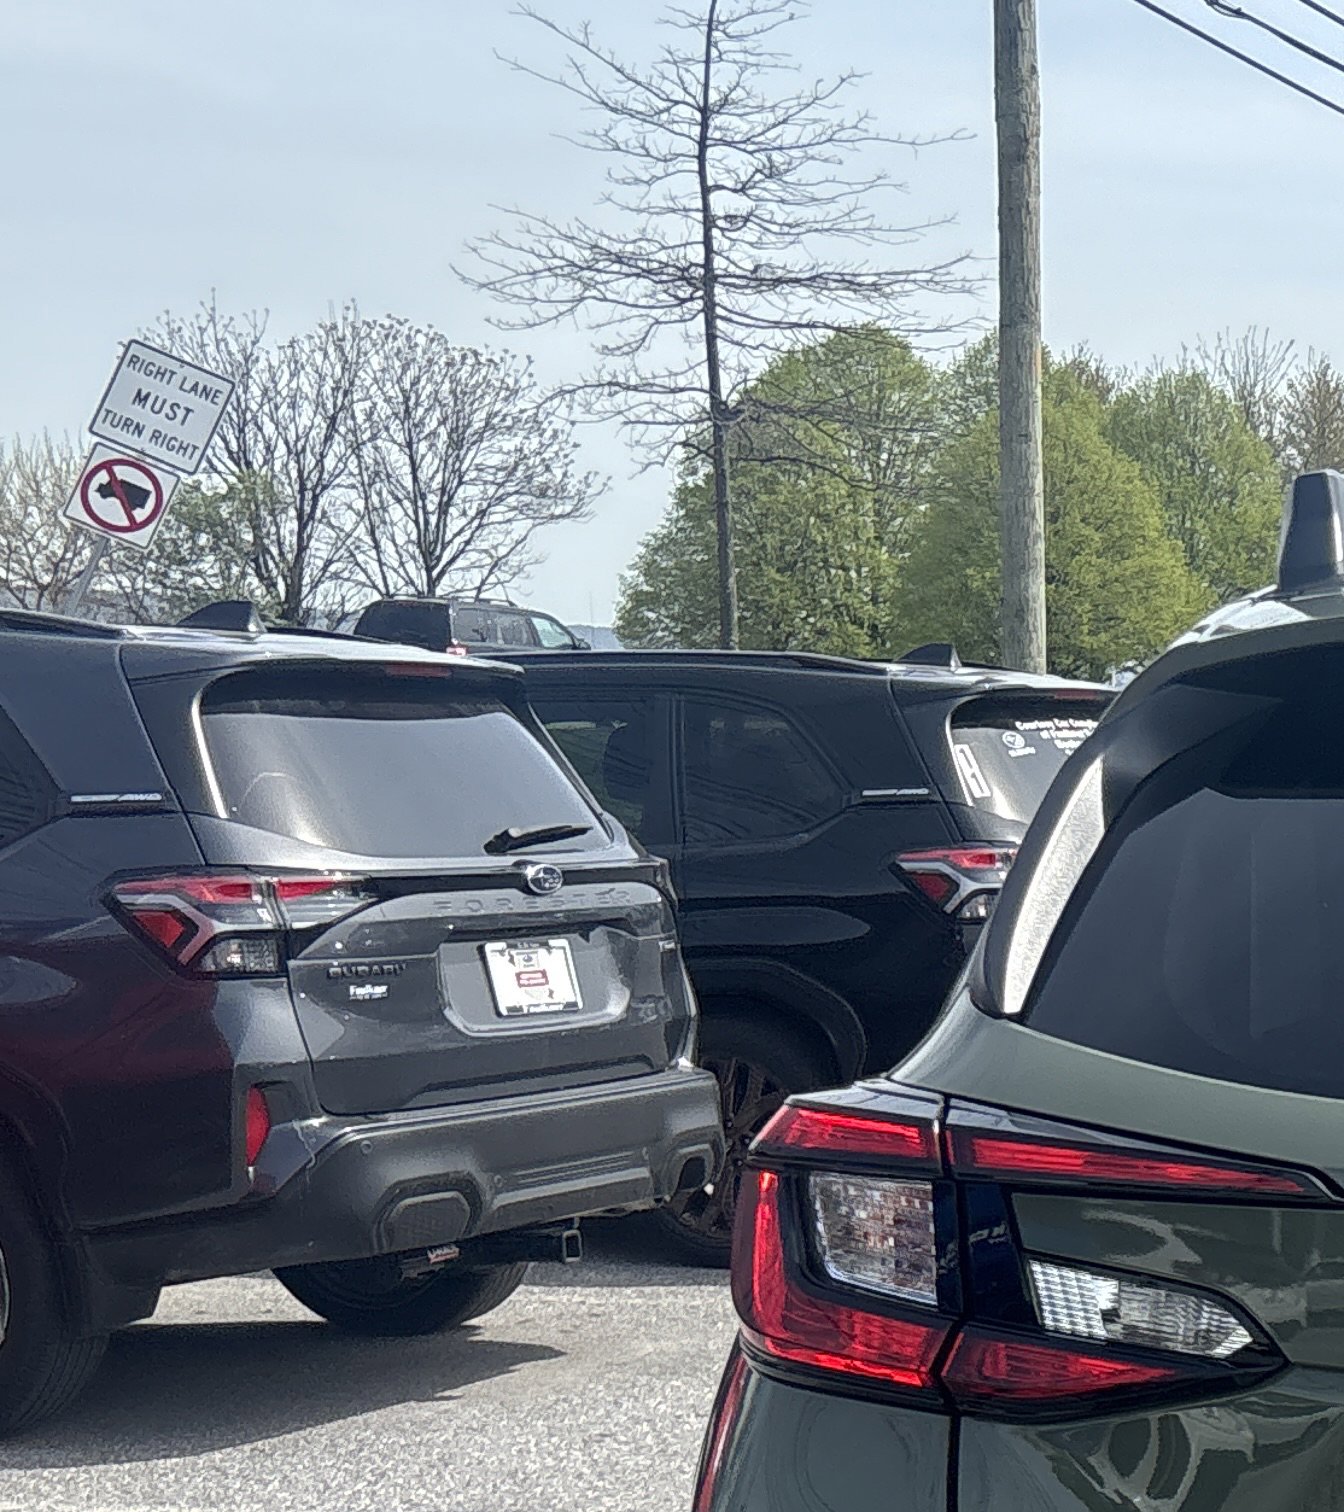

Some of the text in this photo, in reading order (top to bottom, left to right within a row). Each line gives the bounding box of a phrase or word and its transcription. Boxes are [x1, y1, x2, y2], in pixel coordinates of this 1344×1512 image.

[126, 354, 223, 406] RIGHT LANE
[131, 388, 194, 427] MUST
[101, 408, 199, 461] TURN RIGHT
[434, 887, 630, 917] FORESTER
